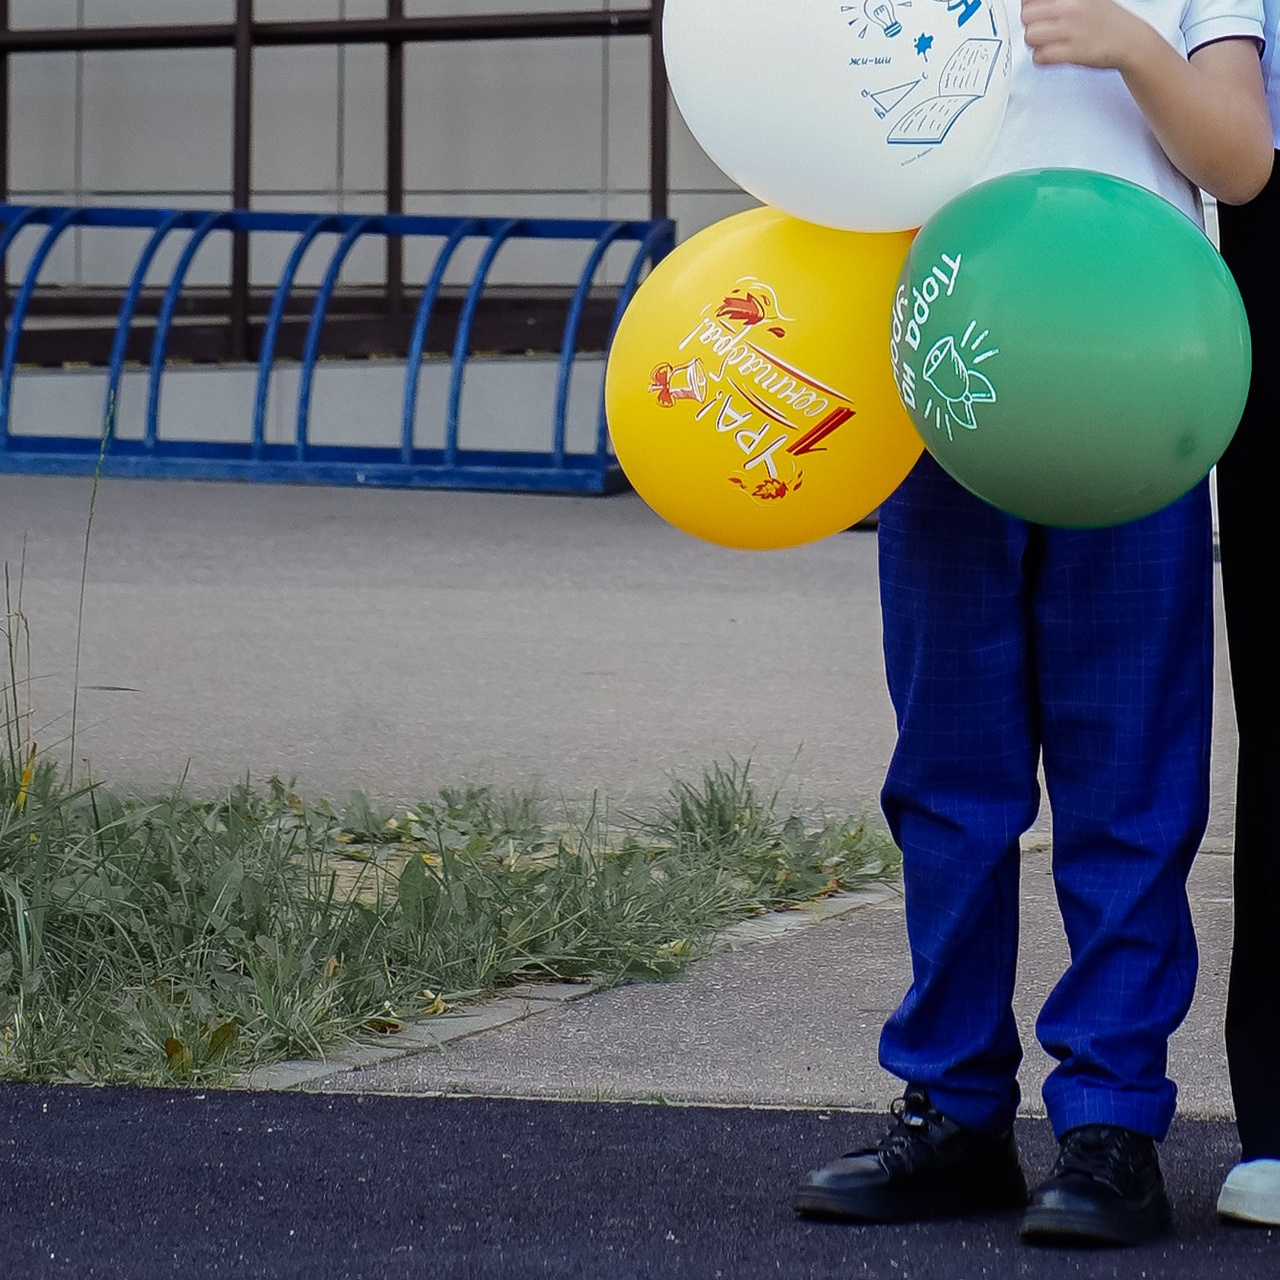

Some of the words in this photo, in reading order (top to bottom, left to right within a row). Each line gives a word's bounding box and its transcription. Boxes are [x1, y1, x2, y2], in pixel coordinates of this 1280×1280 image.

[849, 57, 893, 67] жи-ши
[904, 253, 962, 352] Пора
[678, 316, 830, 418] сентября!
[902, 361, 916, 410] на
[694, 390, 788, 480] УРА!
[786, 406, 857, 456] 1
